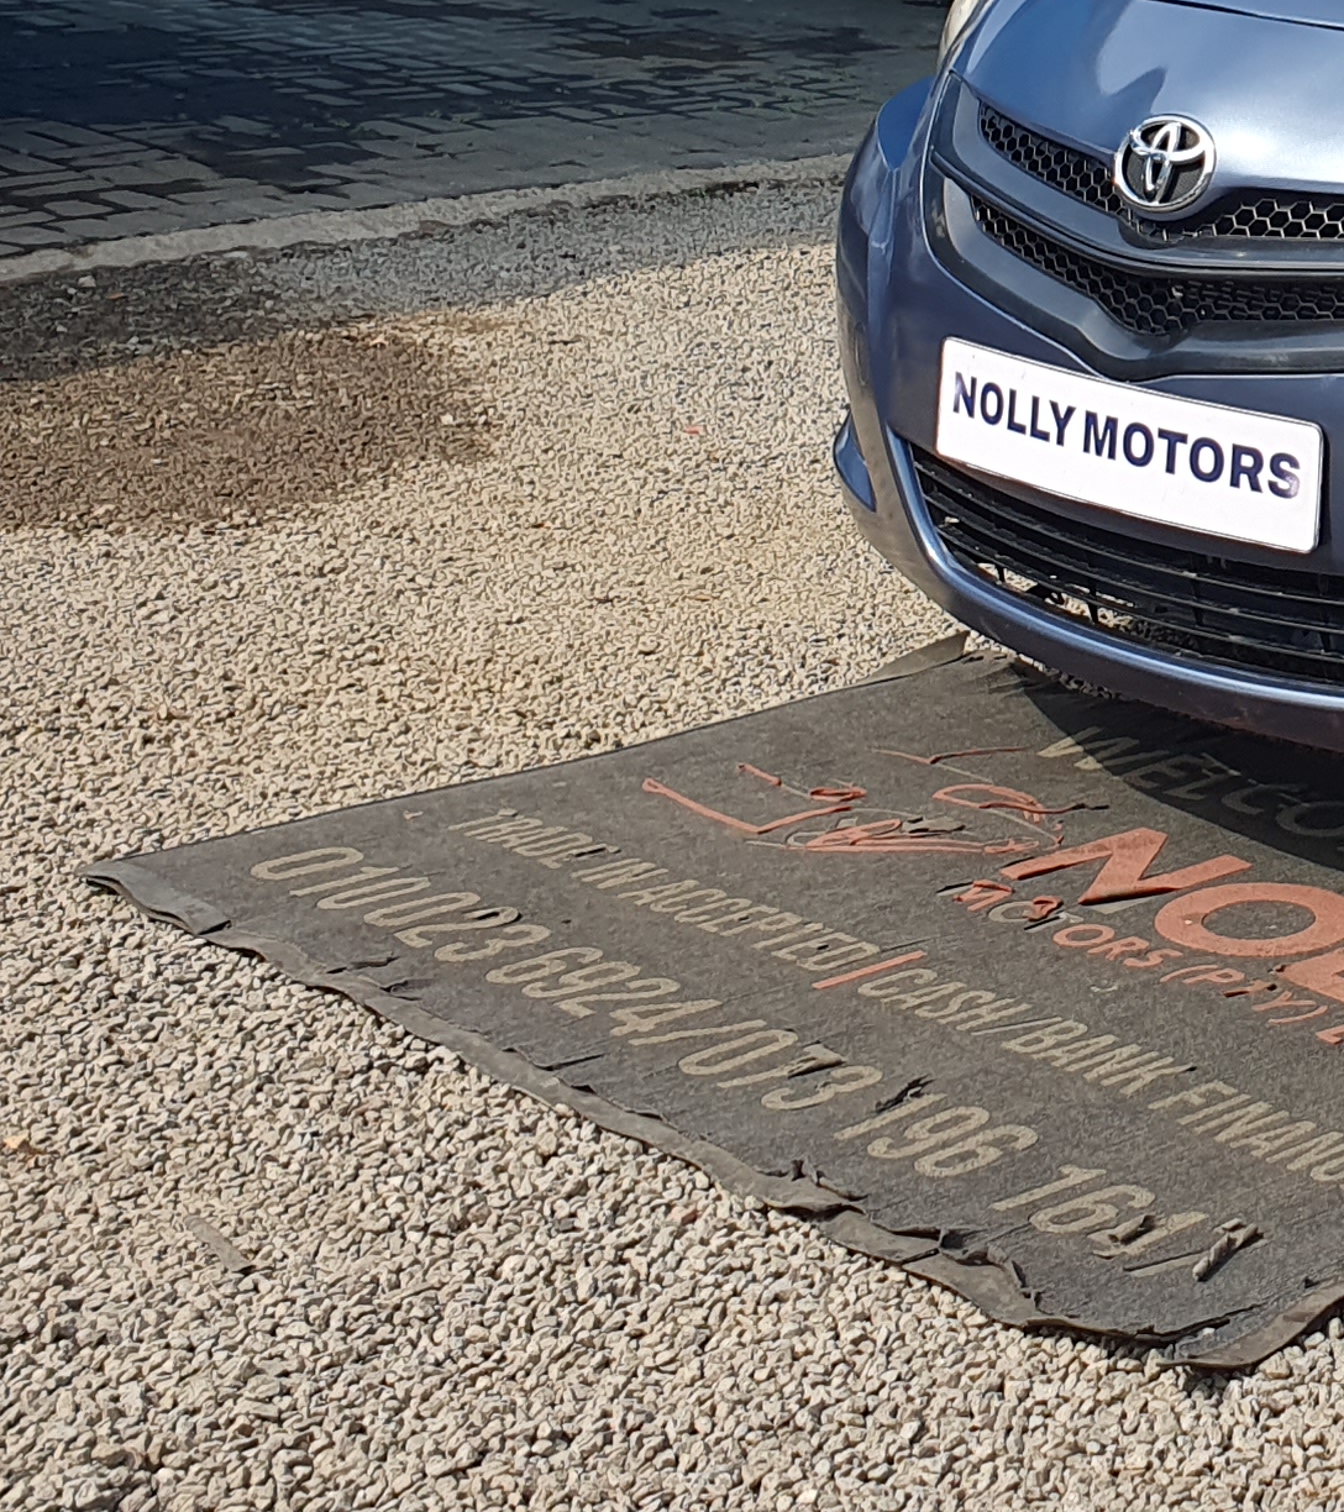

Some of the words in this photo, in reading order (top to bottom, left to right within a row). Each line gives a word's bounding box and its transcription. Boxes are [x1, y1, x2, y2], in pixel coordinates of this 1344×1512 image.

[952, 371, 1077, 447] NOLLY
[1082, 410, 1301, 500] MOTORS
[447, 808, 621, 870] TRADE
[571, 857, 669, 889] IN
[833, 1092, 1039, 1178] 196
